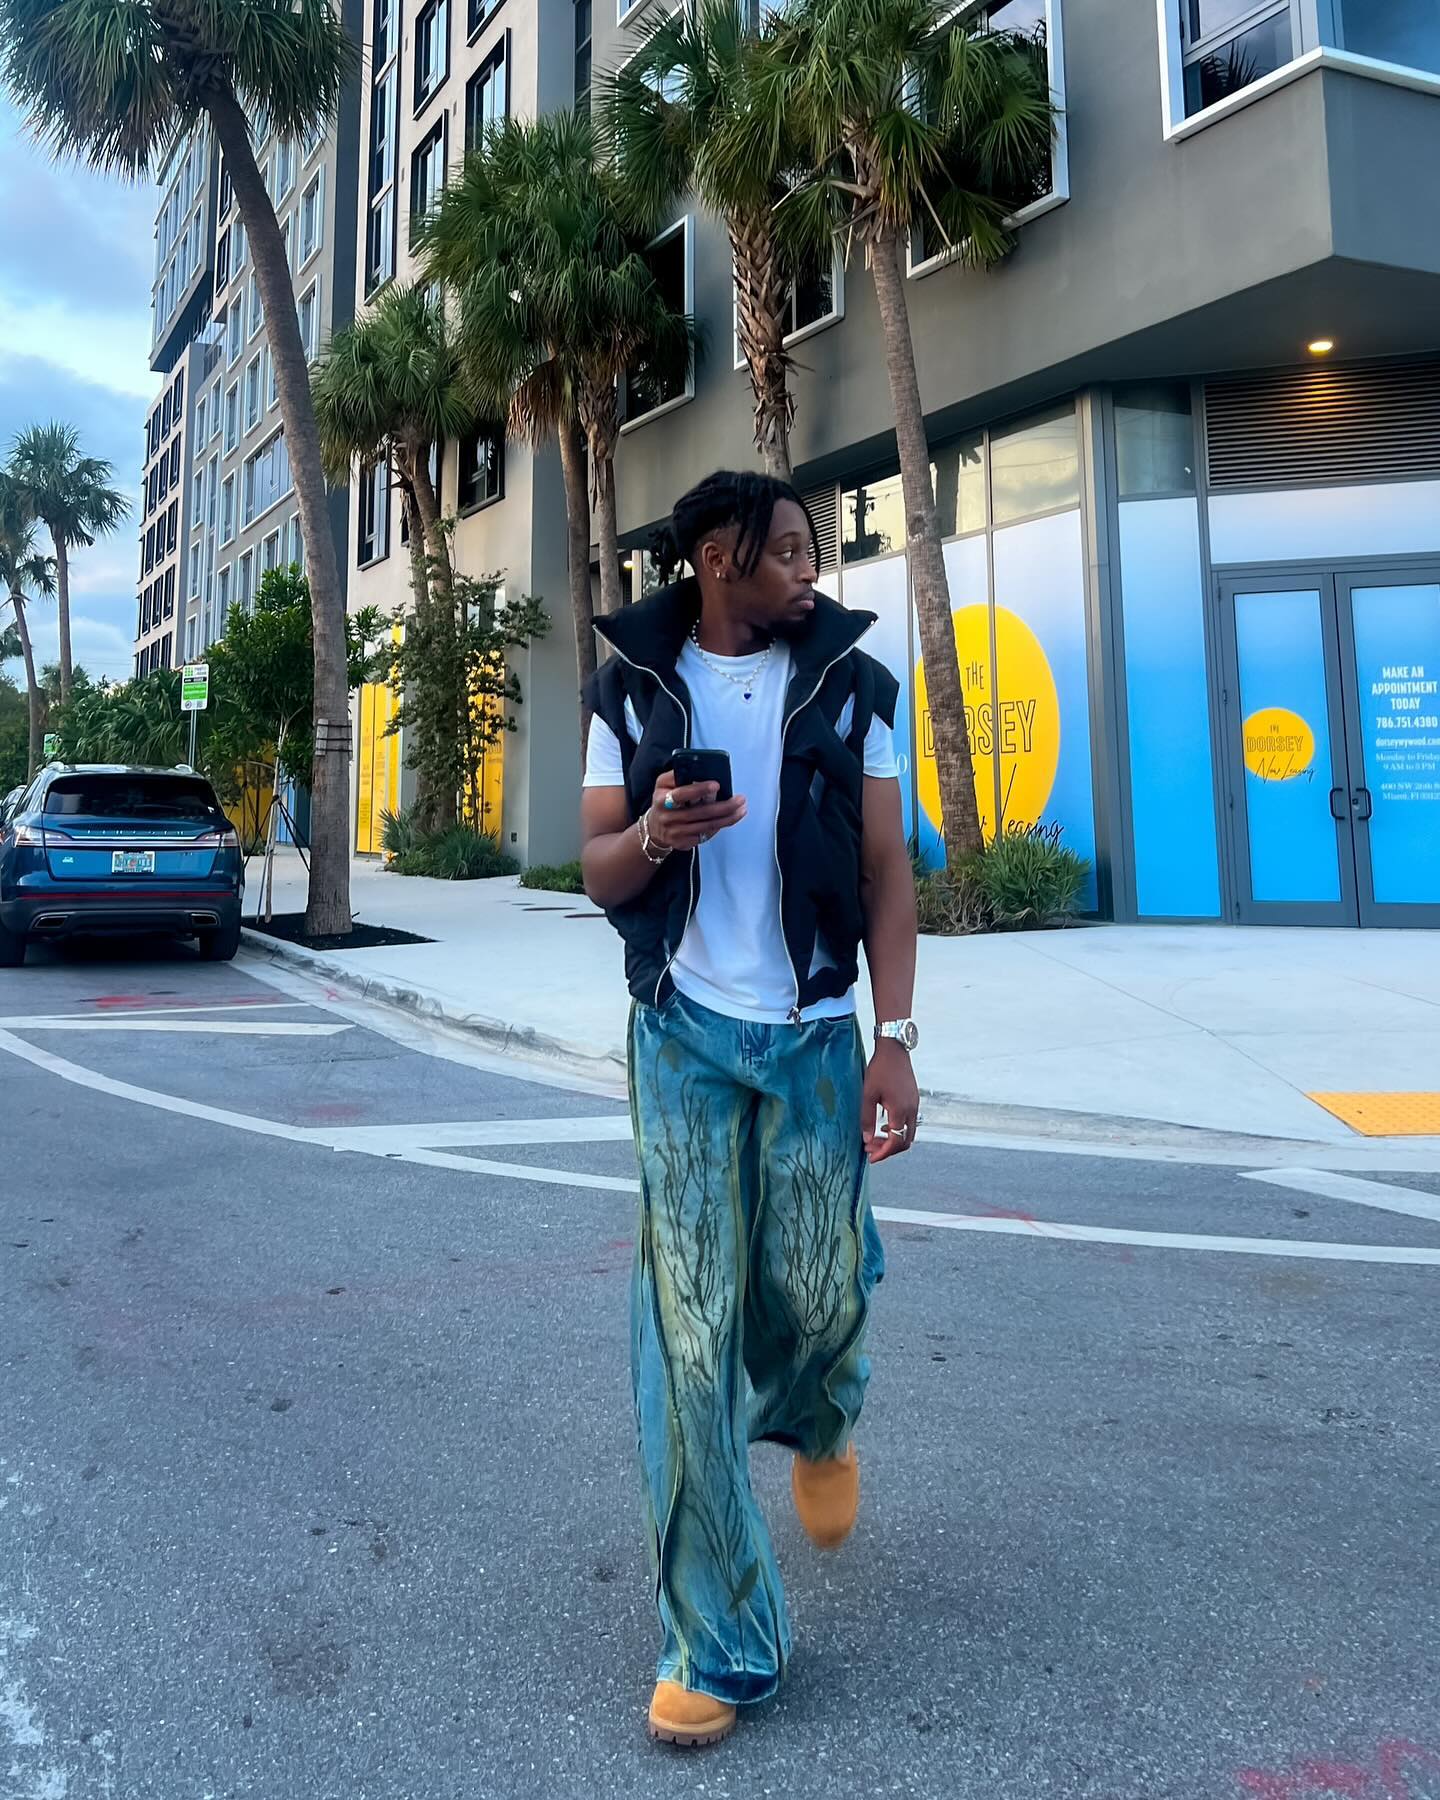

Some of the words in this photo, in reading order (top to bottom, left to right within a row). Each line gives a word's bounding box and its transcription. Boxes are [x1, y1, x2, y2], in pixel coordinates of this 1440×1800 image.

[966, 661, 985, 692] THE
[1382, 666, 1409, 679] MAKE
[1411, 665, 1424, 679] AN
[1372, 681, 1438, 696] APPOINTMENT
[1391, 697, 1421, 710] TODAY
[923, 699, 1036, 758] DRSEY
[1246, 735, 1304, 753] DORSEY
